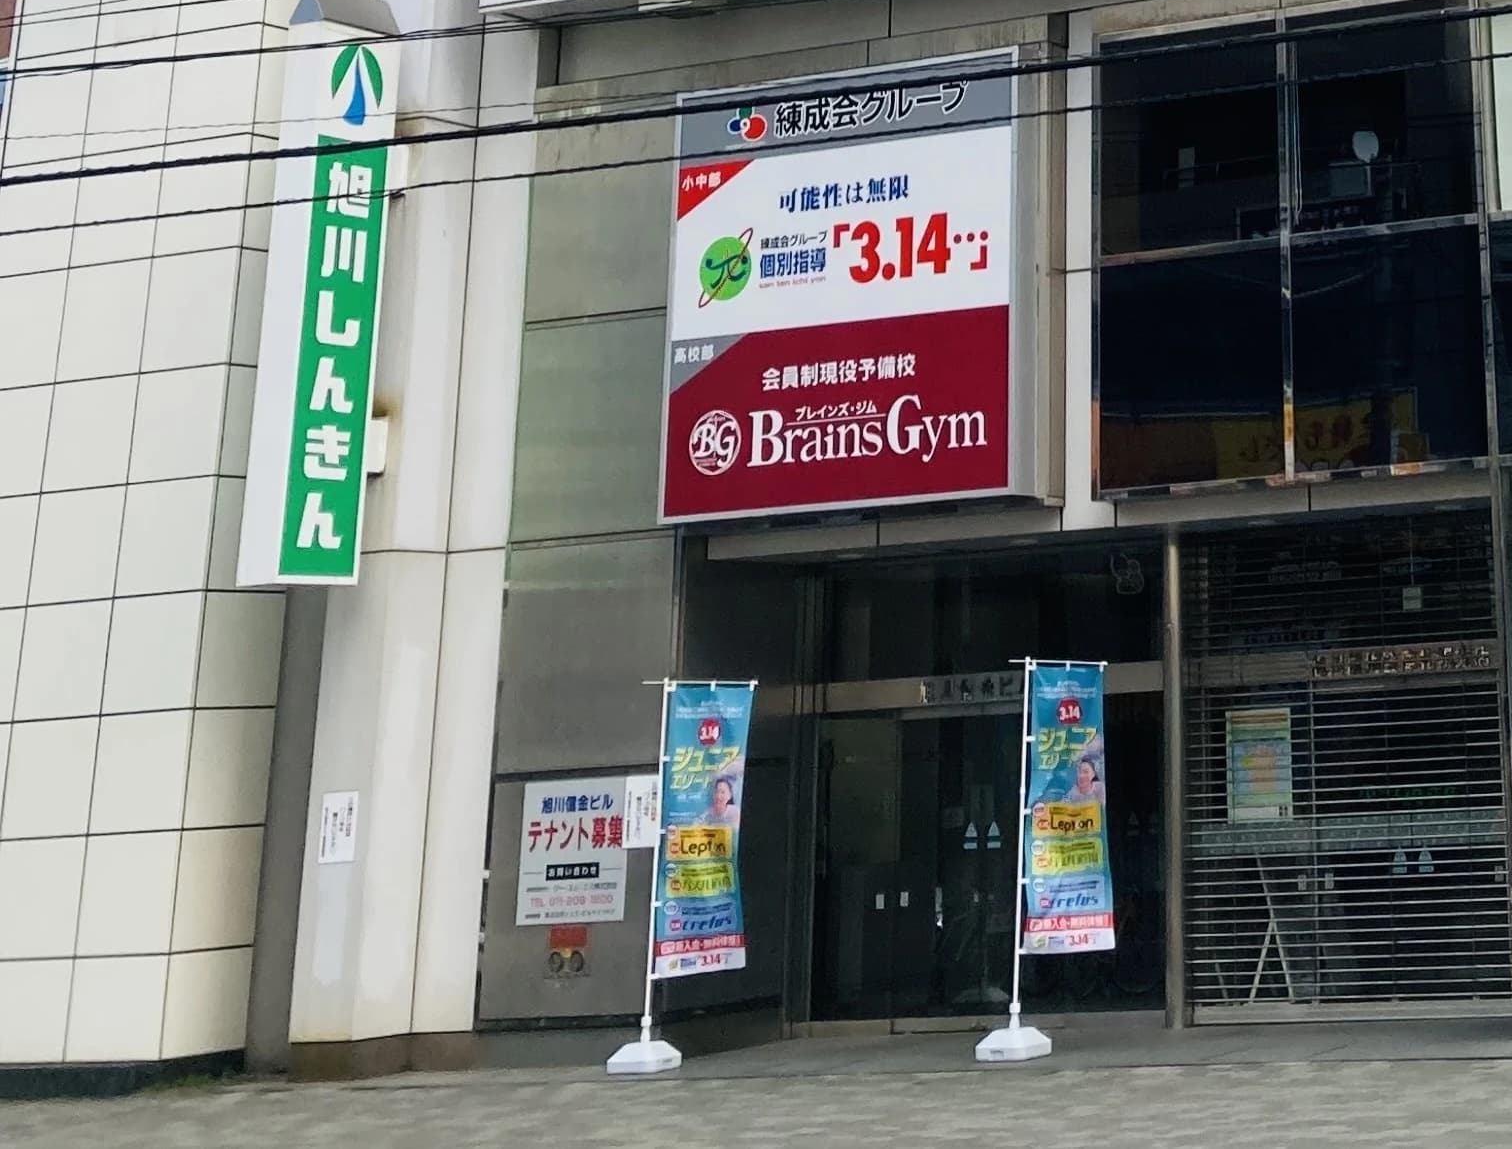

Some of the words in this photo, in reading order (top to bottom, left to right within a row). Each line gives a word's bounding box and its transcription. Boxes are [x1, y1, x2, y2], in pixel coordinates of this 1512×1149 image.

[775, 77, 969, 139] 練成会グループ
[779, 174, 909, 213] 可能性は無限
[760, 247, 826, 280] 個別指導
[296, 162, 373, 549] 旭川しんきん
[761, 353, 917, 392] 会員制現役予備校
[527, 814, 624, 853] テナント募集
